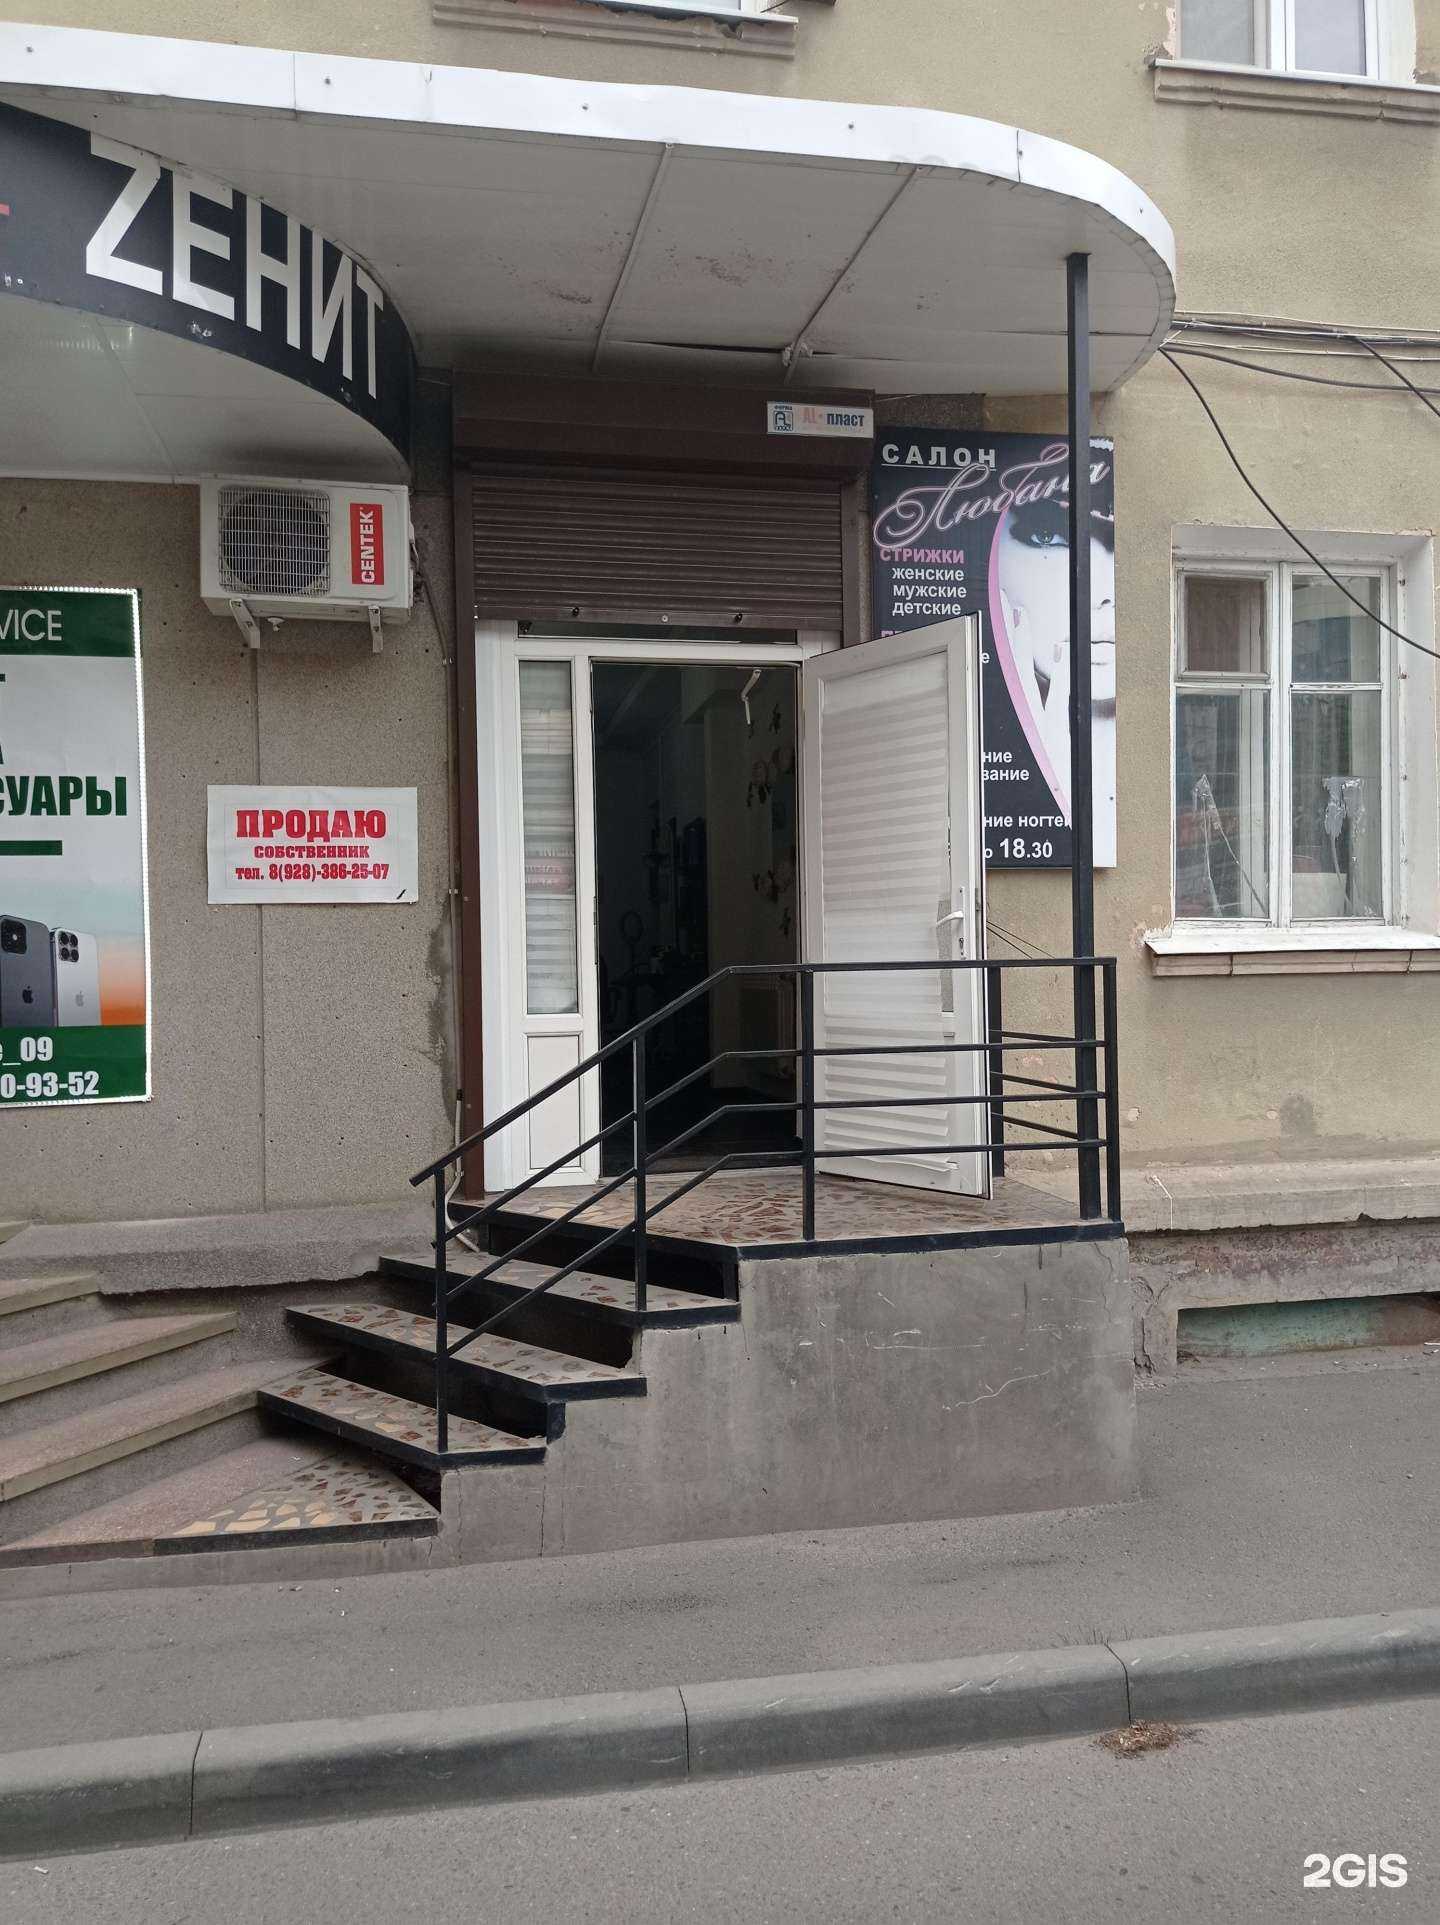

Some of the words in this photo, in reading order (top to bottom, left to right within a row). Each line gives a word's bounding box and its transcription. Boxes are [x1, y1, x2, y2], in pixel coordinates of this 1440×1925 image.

[882, 443, 996, 469] САЛОН
[359, 510, 376, 585] CENTEK
[880, 548, 964, 564] СТРИЖКИ
[892, 567, 965, 581] женские
[893, 584, 967, 601] мужские
[892, 601, 961, 617] детские
[0, 775, 128, 816] УАРЫ
[236, 809, 387, 843] ПРОДАЮ
[254, 845, 370, 858] СОБСТВЕННИК
[999, 838, 1053, 859] 18.30
[235, 867, 265, 880] тел.
[0, 1036, 53, 1066] _09
